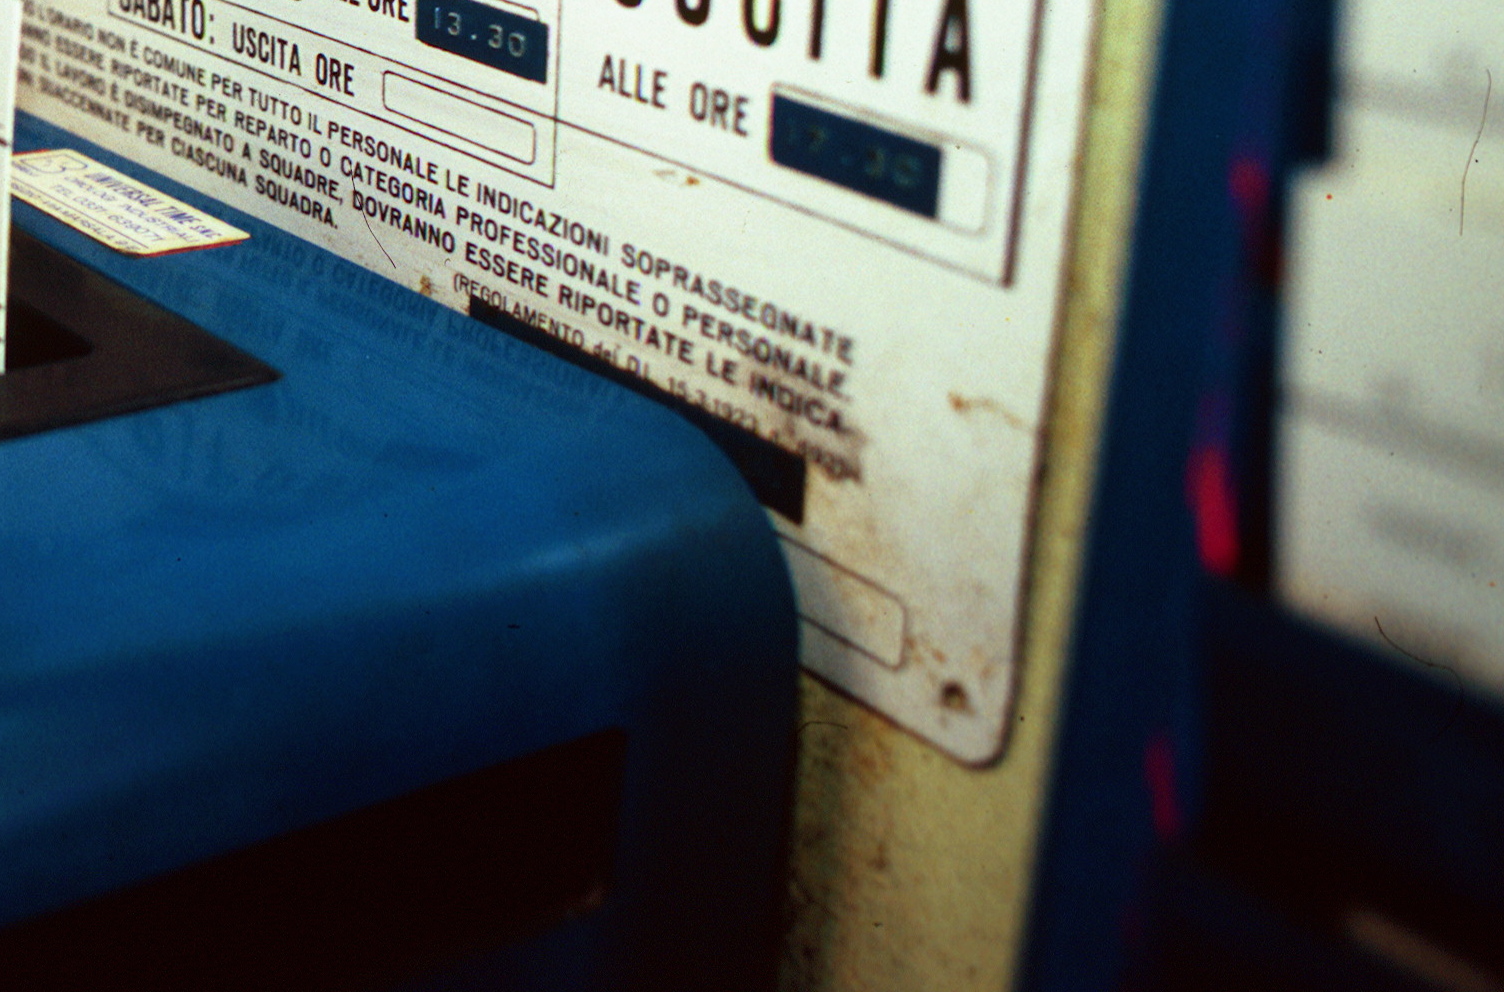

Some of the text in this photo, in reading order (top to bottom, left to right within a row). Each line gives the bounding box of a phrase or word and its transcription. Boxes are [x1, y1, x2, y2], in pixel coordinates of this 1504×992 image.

[232, 22, 301, 76] USCITA
[316, 54, 355, 97] ORE
[433, 6, 527, 58] 13.30
[598, 54, 667, 109] ALLE
[689, 82, 752, 138] ORE
[97, 27, 126, 51] NON
[143, 46, 207, 88] COMUNE
[211, 72, 243, 101] PER
[248, 86, 302, 126] TUTTO
[308, 112, 323, 135] IL
[328, 120, 439, 185] PERSONALE
[446, 169, 470, 197] LE
[476, 182, 610, 257] INDICAZIONI
[621, 243, 855, 366] SOPRASSEGNATE
[111, 58, 190, 108] RIPORTATE
[196, 94, 227, 123] PER
[234, 109, 312, 159] REPARTO
[319, 145, 331, 168] O
[340, 155, 447, 220] CATEGORIA
[455, 205, 643, 307] PROFESSIONALE
[651, 291, 671, 318] O
[136, 120, 165, 149] PER
[171, 136, 248, 188] CIASCUNA
[255, 174, 339, 230] SQUADRA.
[124, 89, 234, 154] DISIMPEGNATO
[242, 142, 253, 162] A
[259, 148, 344, 206] SQUADRE,
[352, 189, 456, 254] DOVRANNO
[465, 241, 550, 299] ESSERE
[558, 283, 695, 367] RIPORTATE
[706, 351, 738, 387] LE
